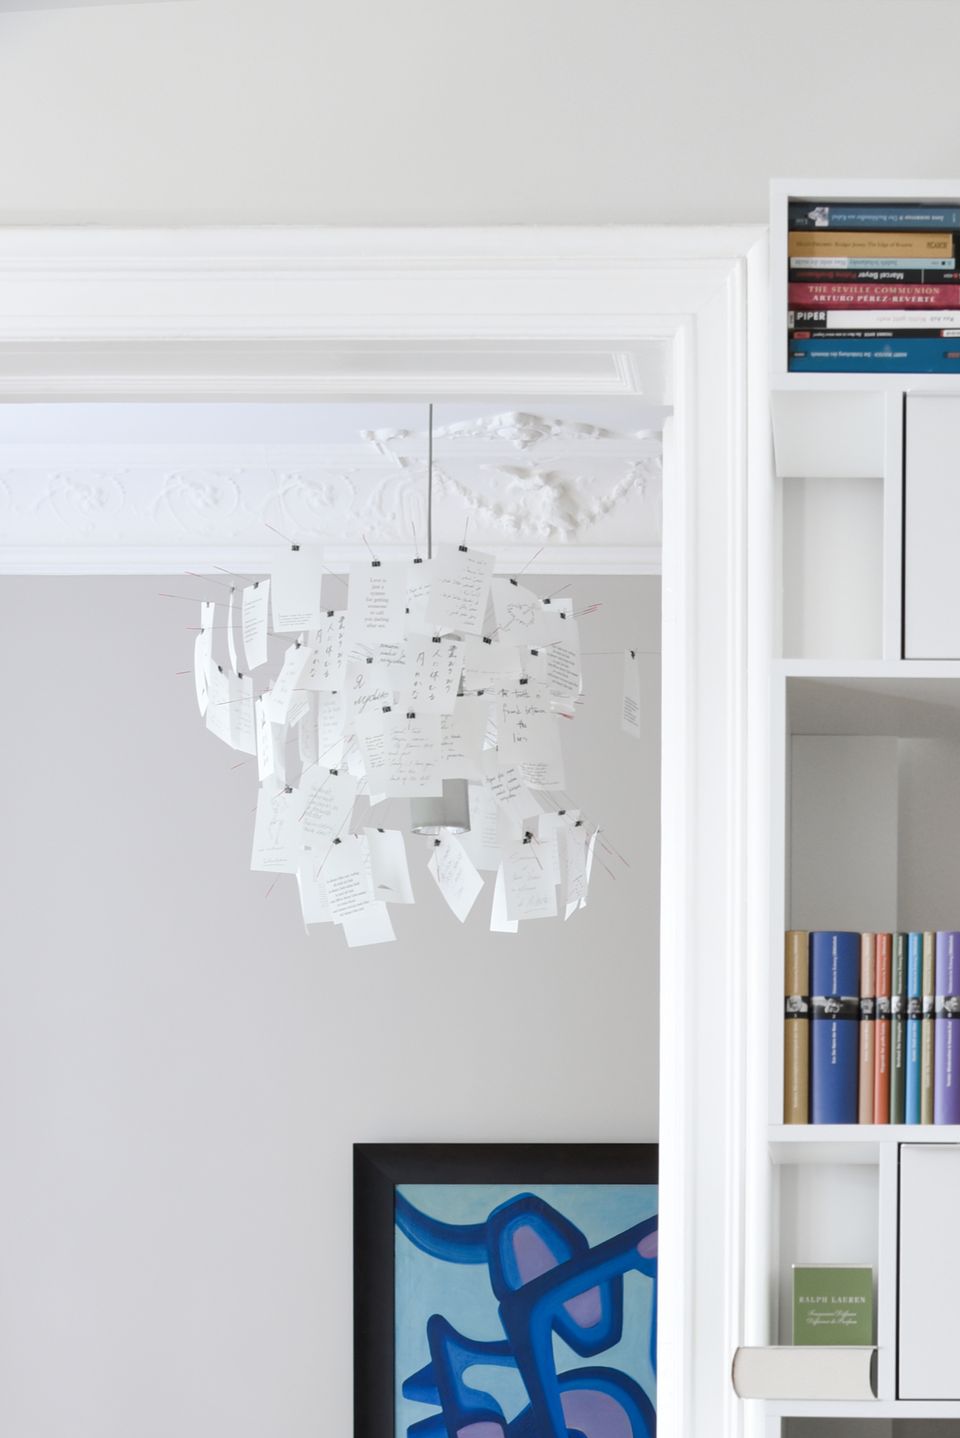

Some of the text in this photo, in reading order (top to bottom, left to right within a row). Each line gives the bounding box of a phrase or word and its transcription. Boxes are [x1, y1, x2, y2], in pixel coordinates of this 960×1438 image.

[858, 272, 904, 280] Marcel Beyer
[809, 286, 939, 294] THE SEVILLE COMMUNION
[796, 312, 825, 320] PIPER
